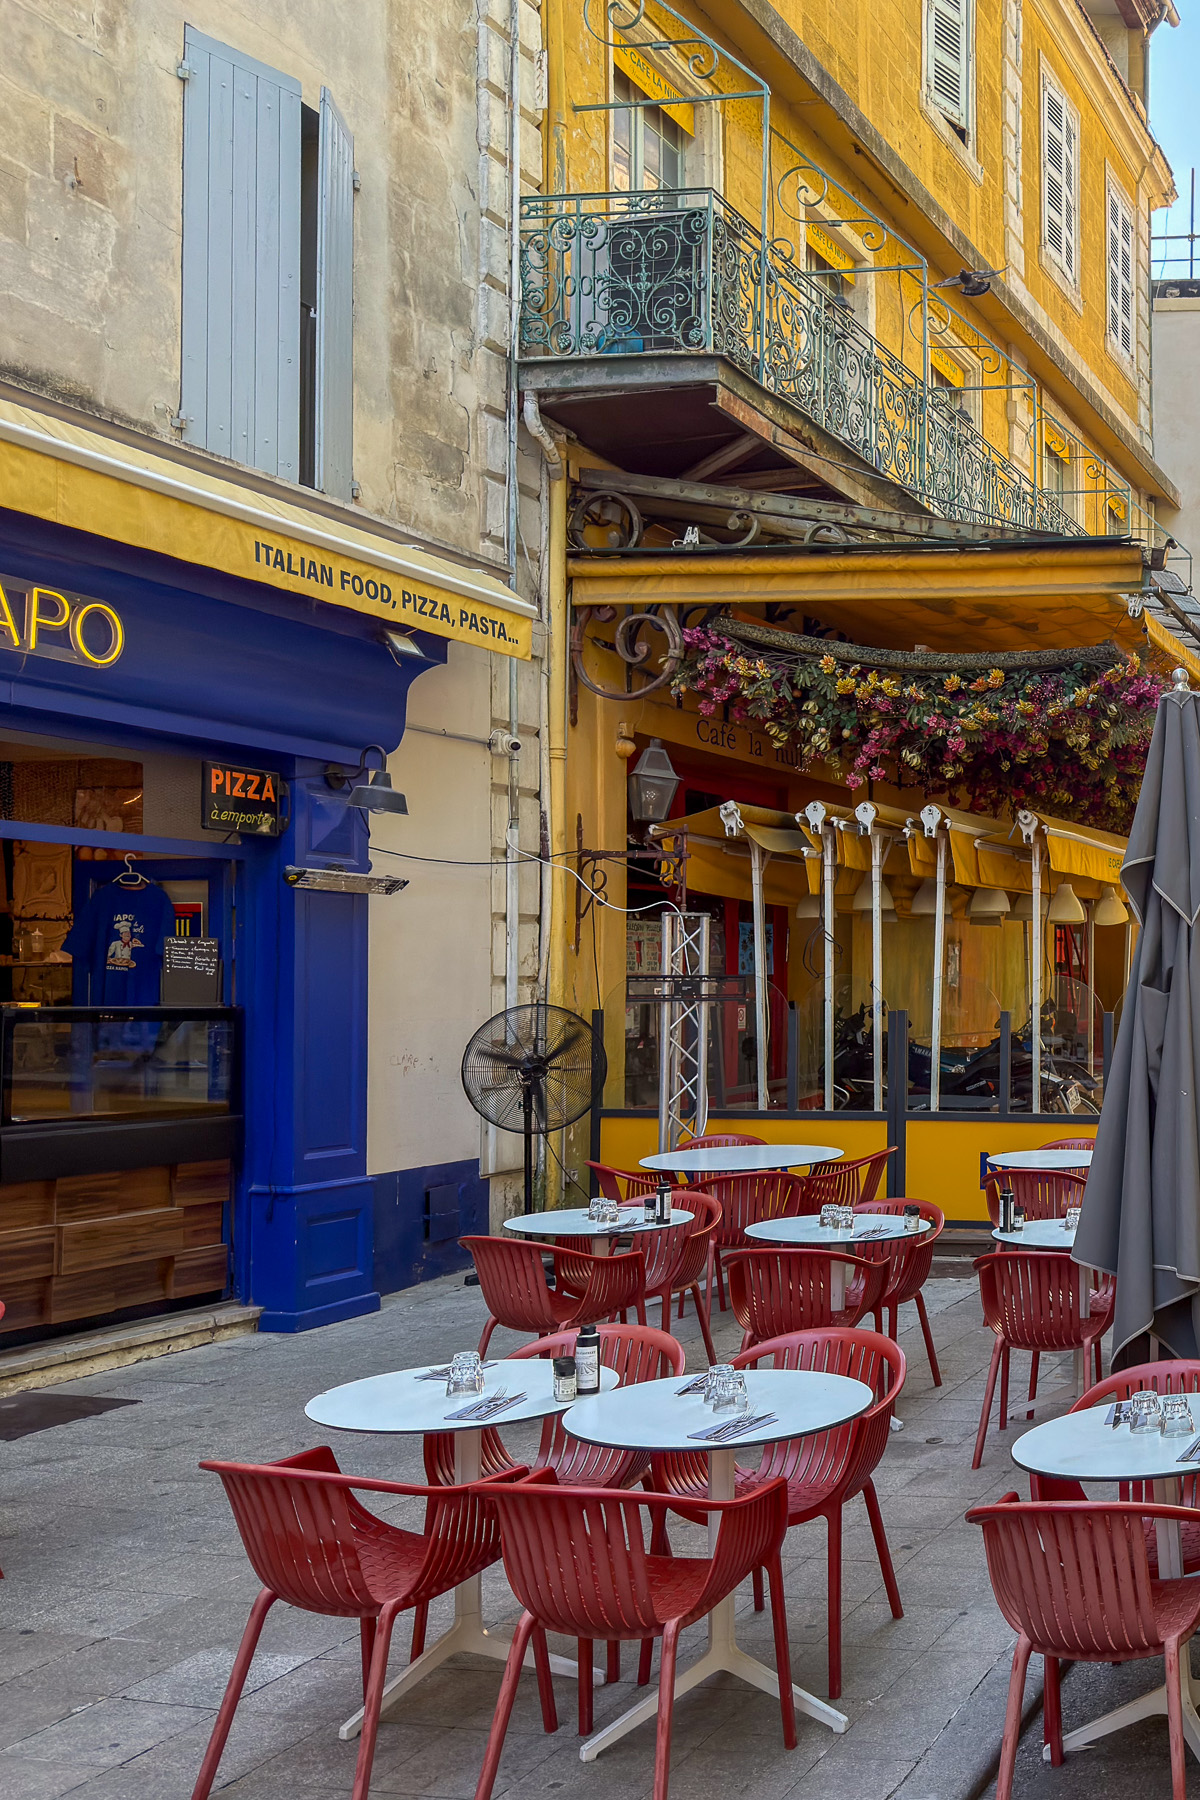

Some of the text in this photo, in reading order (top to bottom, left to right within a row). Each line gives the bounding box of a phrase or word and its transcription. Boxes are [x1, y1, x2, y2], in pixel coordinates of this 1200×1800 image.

[630, 51, 651, 79] CAFE
[652, 73, 663, 91] LA
[254, 540, 519, 645] ITALIAN FOOD, PIZZA, PASTA...
[696, 720, 737, 750] Café
[749, 732, 763, 757] la
[211, 768, 276, 803] PIZZA
[211, 802, 276, 829] à emporter
